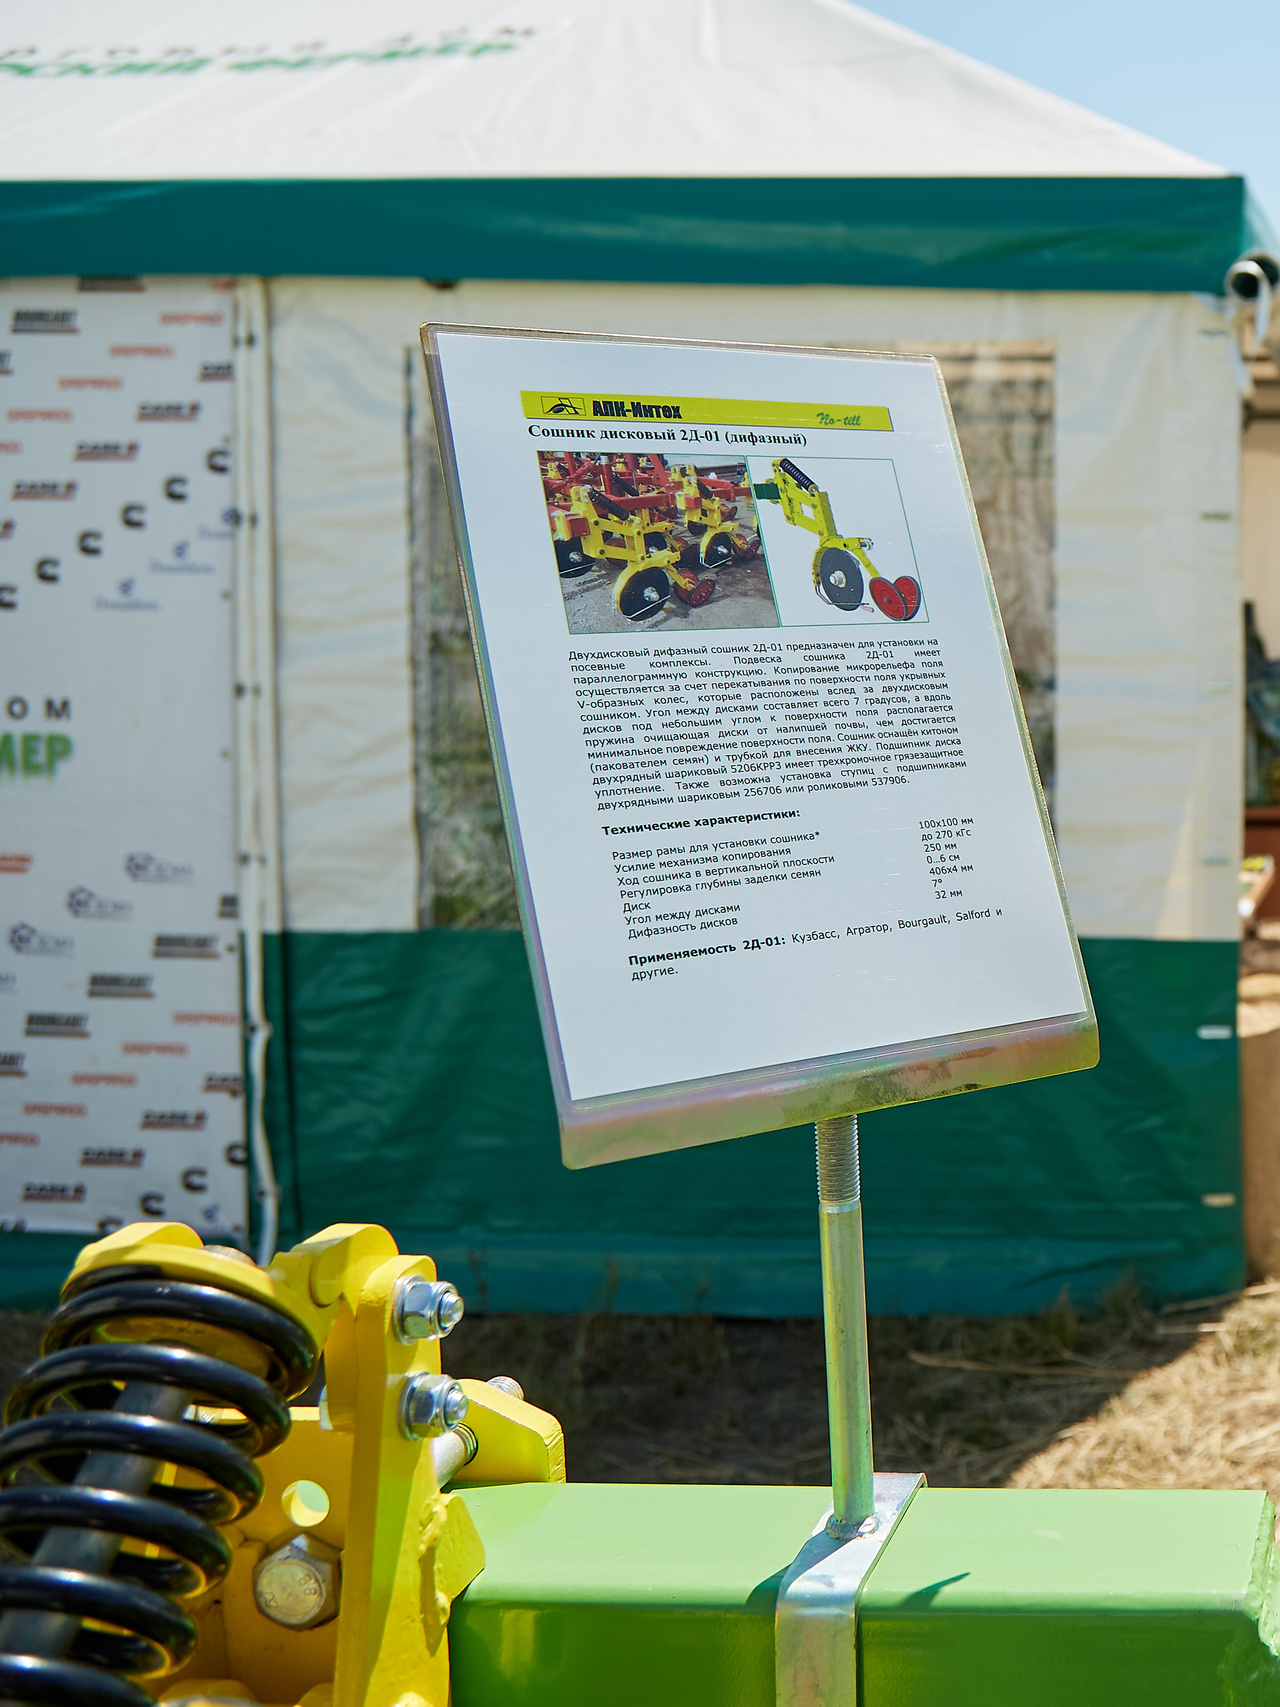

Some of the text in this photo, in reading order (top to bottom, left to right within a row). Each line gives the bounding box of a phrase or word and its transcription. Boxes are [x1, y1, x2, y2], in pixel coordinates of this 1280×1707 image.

[592, 400, 683, 420] АПК-Интех
[816, 412, 861, 426] No-till
[527, 423, 807, 447] Сошник дисковый 2Д-01 (дифазный)
[567, 638, 939, 662] Двухдисковый дифазный сошник 2Д-01 предназначен для установки на
[576, 682, 949, 710] V-образных колес, которые расположены вслед за двухдисковым
[586, 726, 959, 760] минимальное повреждение поверхности поля. Сошник оснащён китоном
[600, 809, 801, 836] Технические характеристики:
[960, 817, 974, 825] мм
[920, 827, 972, 842] до 270 кГс
[611, 848, 653, 861] Размер
[655, 845, 686, 858] рамы
[688, 843, 709, 854] для
[711, 837, 768, 852] установки
[923, 842, 958, 853] 250 мм
[948, 853, 961, 862] см
[613, 847, 792, 874] Усилие механизма копирования
[616, 855, 835, 887] Ход сошника в вертикальной плоскости
[959, 864, 974, 873] мм
[619, 869, 822, 899] Регулировка глубины заделки семян
[934, 889, 963, 900] 32 мм
[622, 901, 652, 914] Диск
[623, 904, 741, 926] Угол между дисками
[627, 917, 739, 941] Дифазность дисков
[627, 907, 1003, 967] Применяемость 2Д-01: Кузбасс, Агратор, Bourgault, Salford и
[631, 966, 679, 982] другие.
